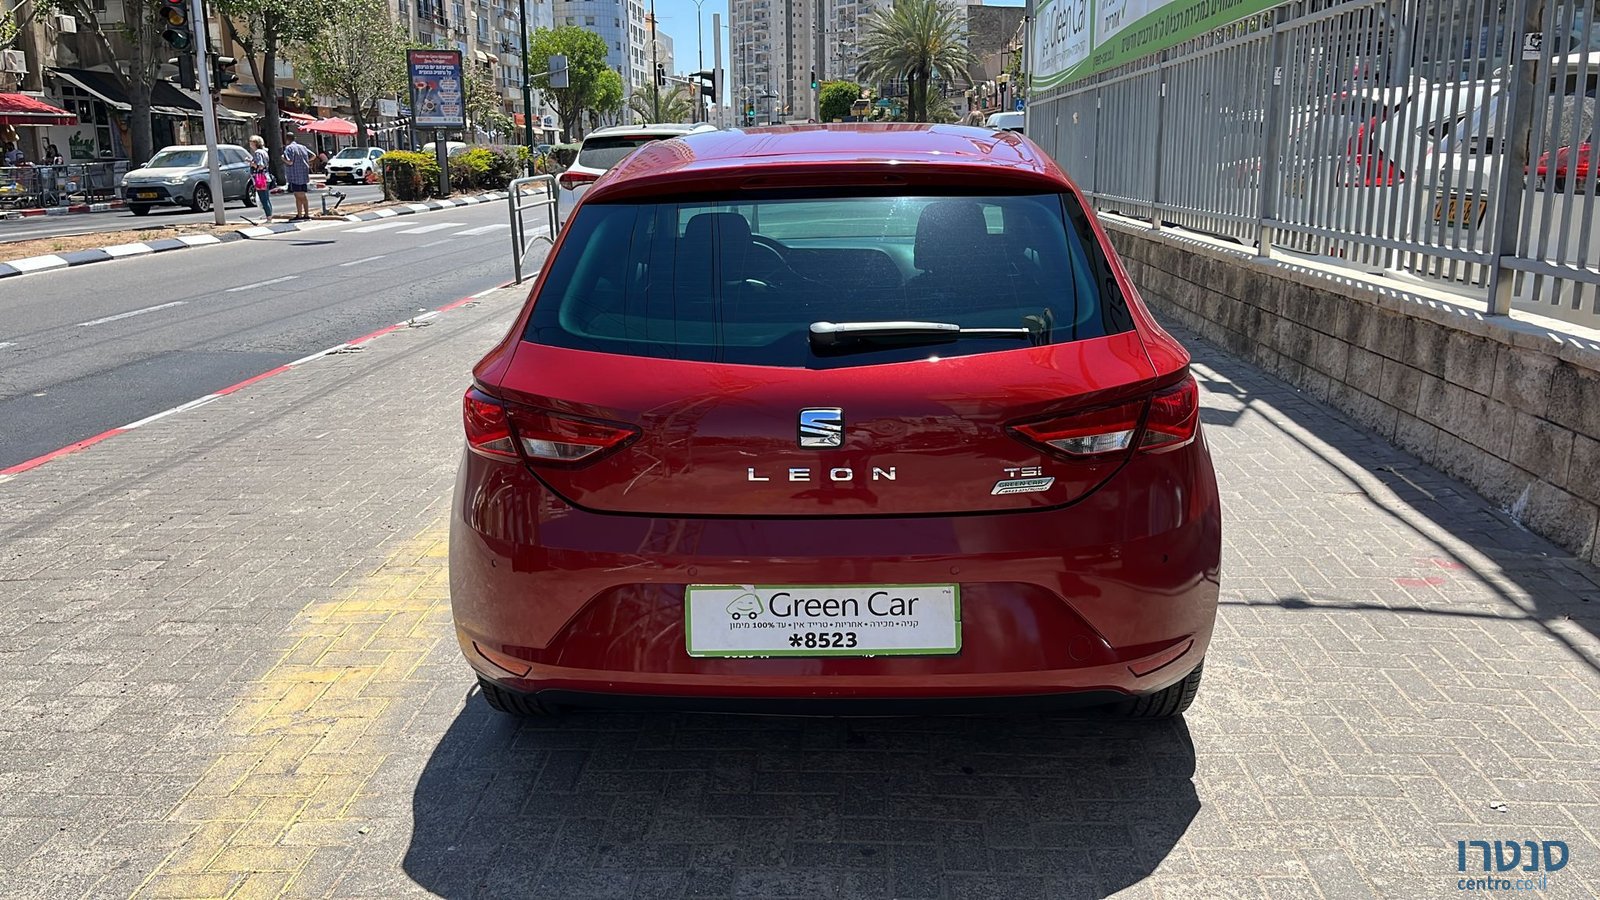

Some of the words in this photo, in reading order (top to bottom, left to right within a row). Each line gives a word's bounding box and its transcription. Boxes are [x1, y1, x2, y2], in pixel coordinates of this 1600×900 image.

[747, 467, 896, 481] LEON
[769, 592, 859, 618] Green
[867, 591, 919, 617] Car
[729, 622, 750, 630] מימון
[793, 622, 805, 630] אין
[901, 621, 919, 629] קניה
